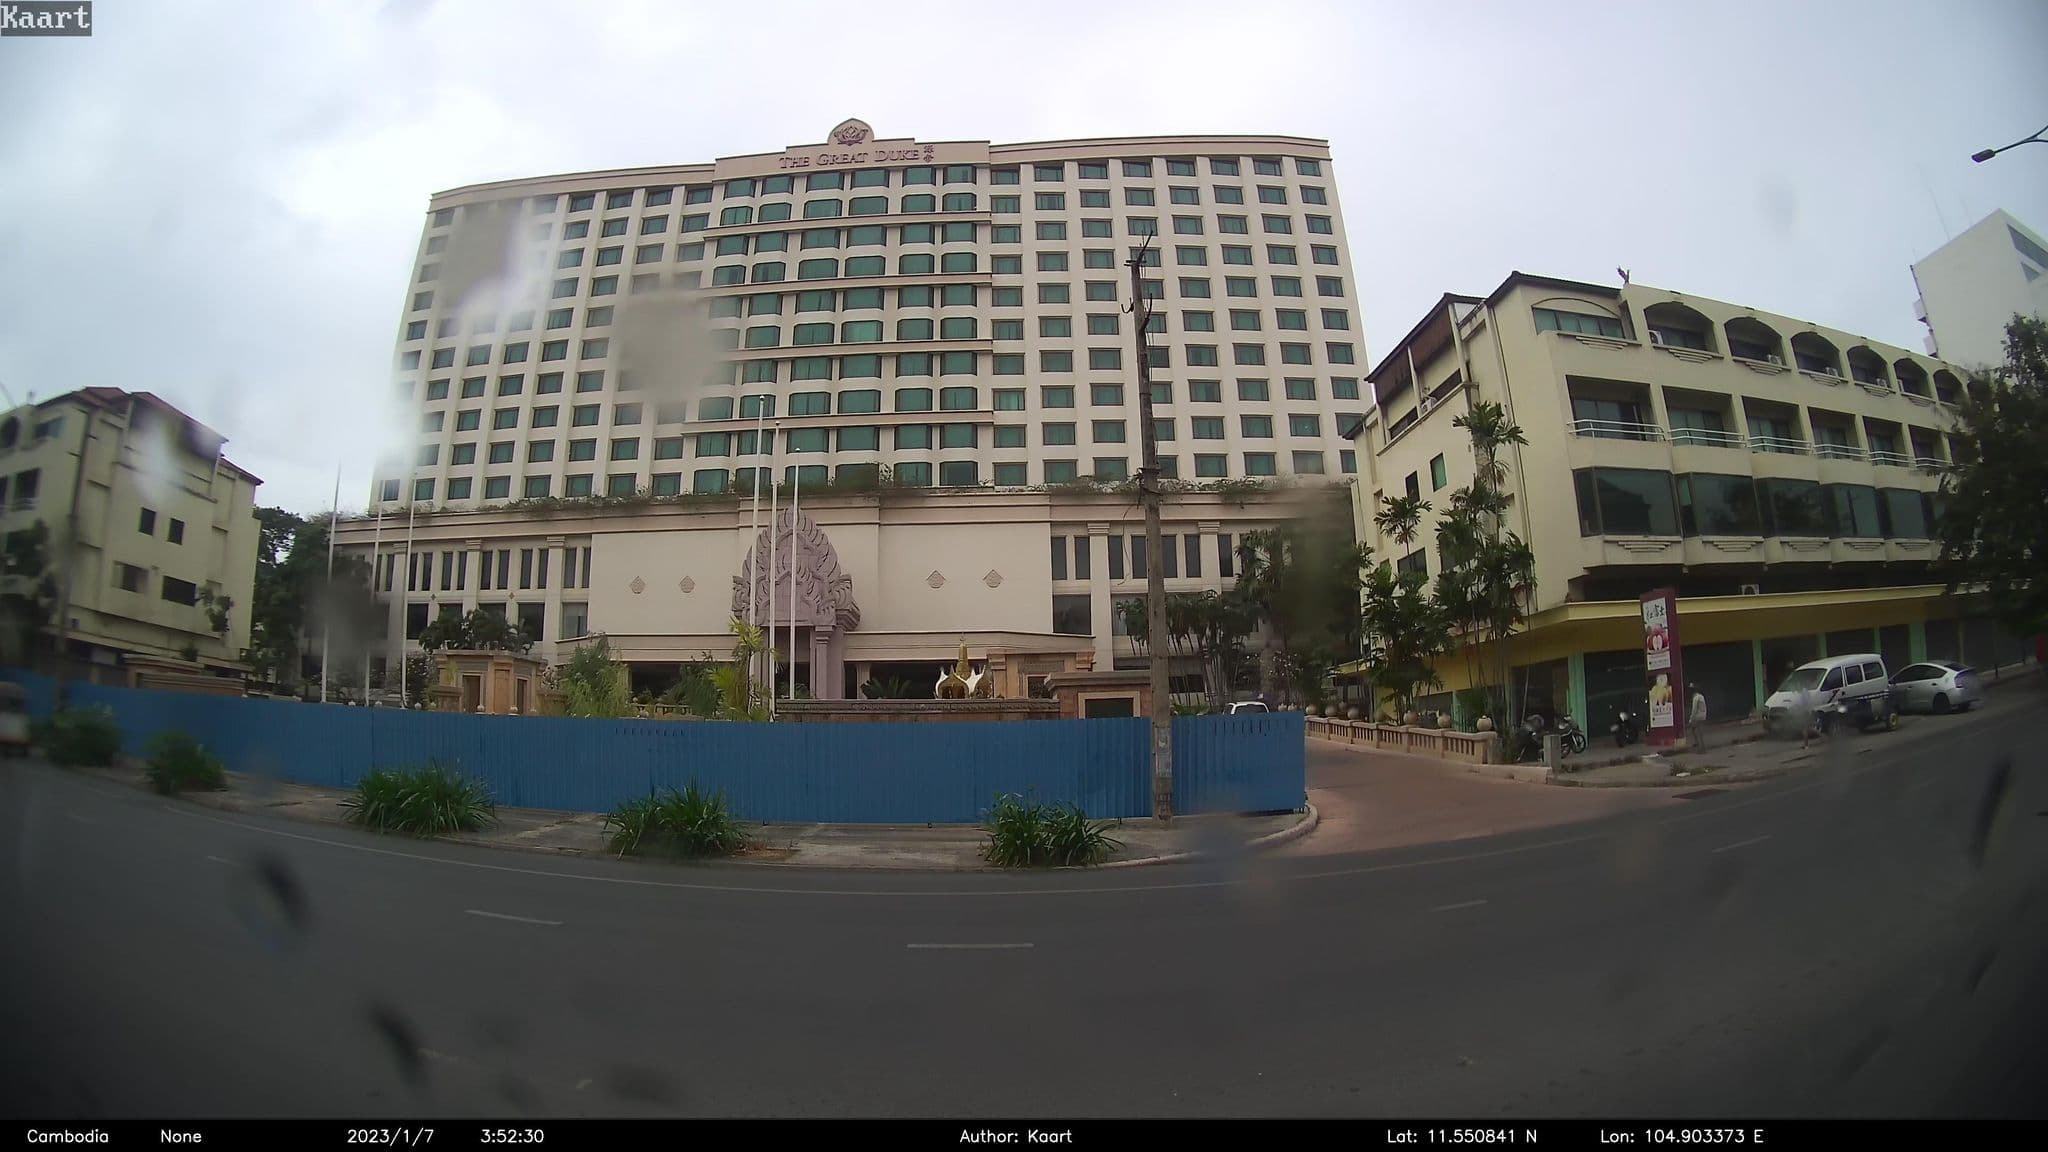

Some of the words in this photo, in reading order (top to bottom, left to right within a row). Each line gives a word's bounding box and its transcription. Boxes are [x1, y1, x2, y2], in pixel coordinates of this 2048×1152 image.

[779, 156, 810, 169] THE
[816, 152, 868, 166] GREAT
[874, 149, 919, 162] DUKE
